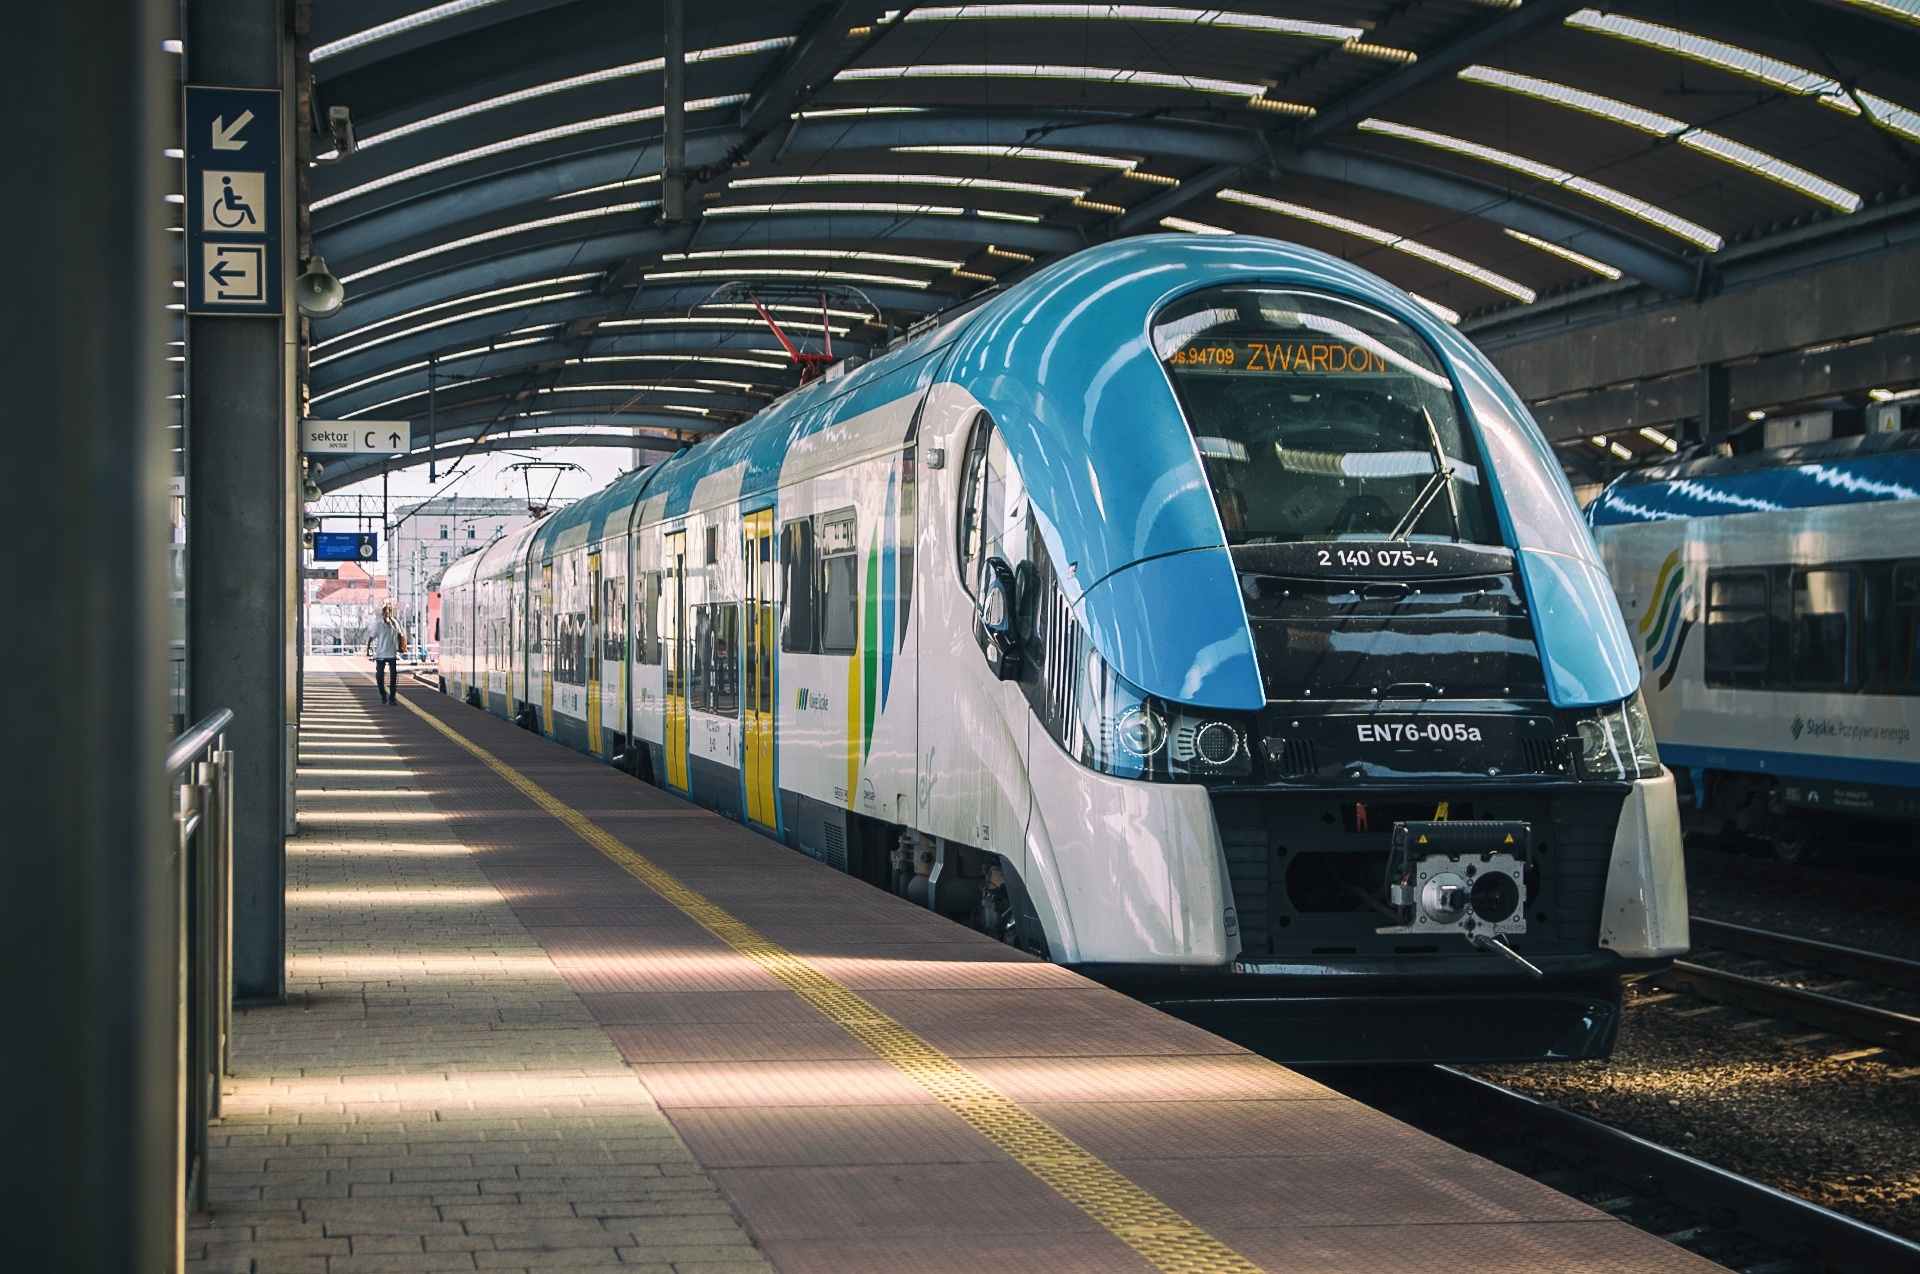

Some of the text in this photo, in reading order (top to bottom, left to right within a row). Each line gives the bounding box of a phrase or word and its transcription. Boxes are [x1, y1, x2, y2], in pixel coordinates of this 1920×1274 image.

[311, 430, 349, 442] sektor
[365, 431, 376, 449] C
[1317, 550, 1439, 567] 2 140 075-4
[1356, 723, 1482, 742] EN76-005a
